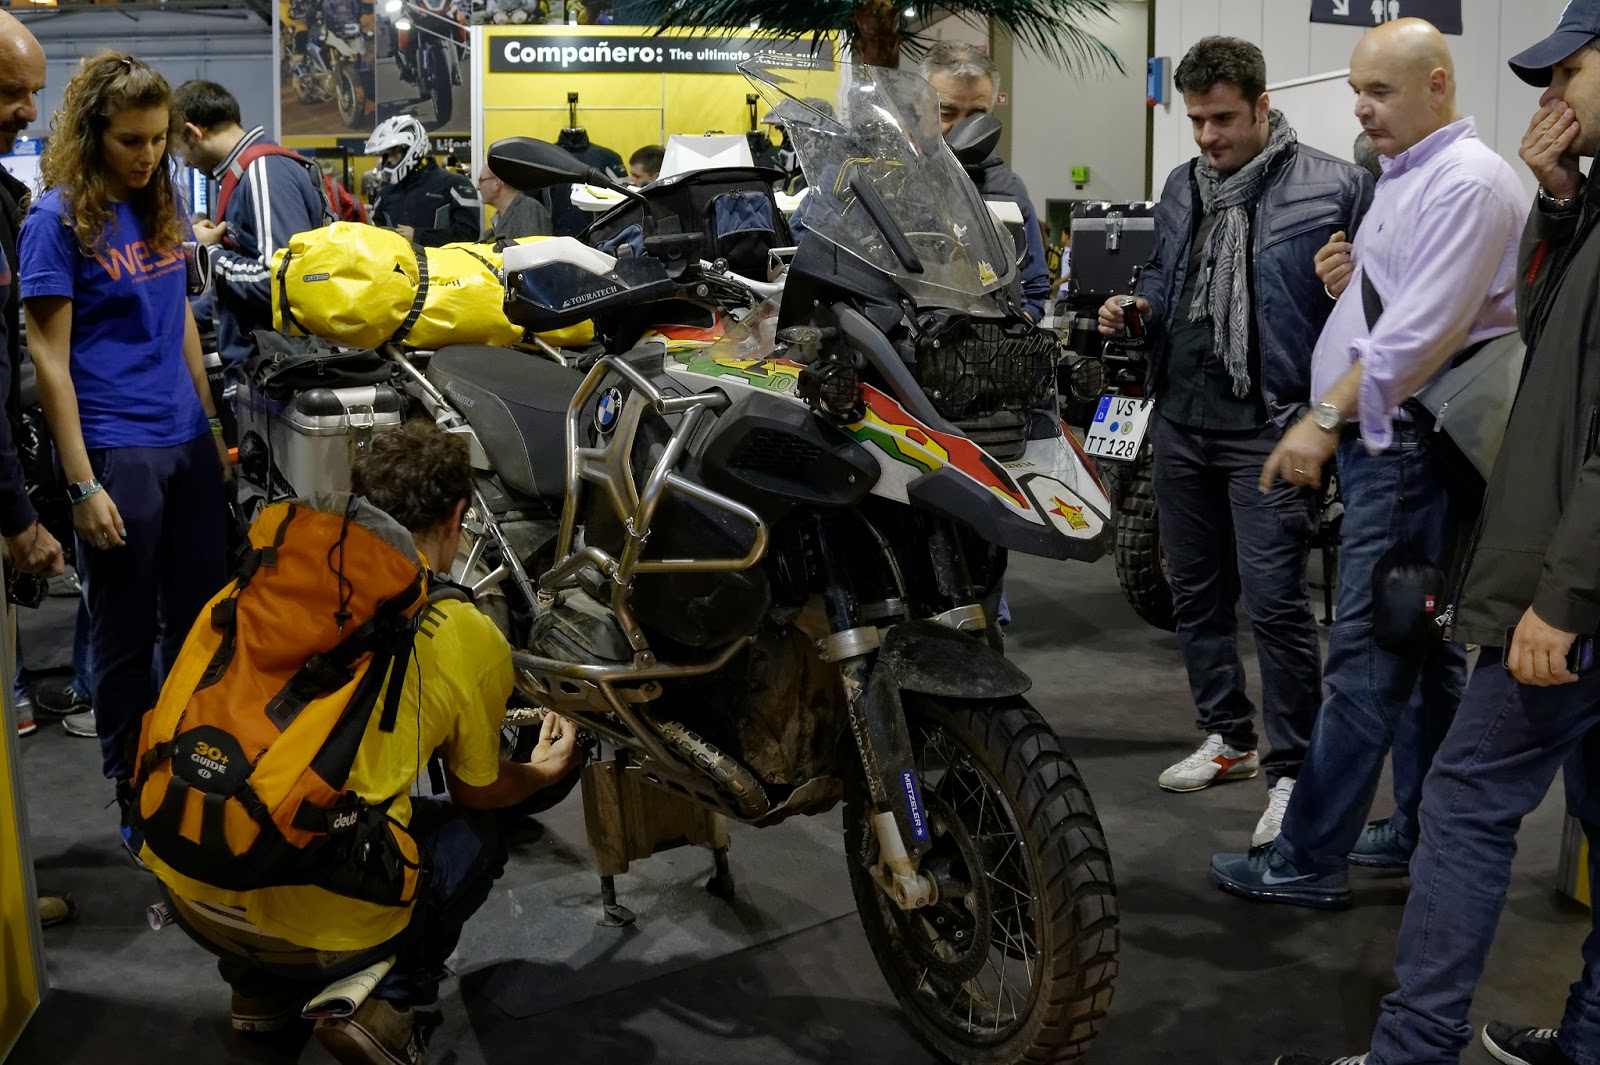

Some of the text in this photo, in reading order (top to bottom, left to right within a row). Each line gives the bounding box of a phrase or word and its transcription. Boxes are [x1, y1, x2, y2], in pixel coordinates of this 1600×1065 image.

[504, 41, 663, 68] Compañero:
[668, 48, 694, 60] The
[696, 48, 751, 60] ultimate
[570, 285, 618, 305] TOURATECH
[1116, 399, 1136, 416] VS
[190, 753, 227, 774] GUIDE
[194, 741, 229, 764] 30+
[903, 773, 922, 827] METZELER
